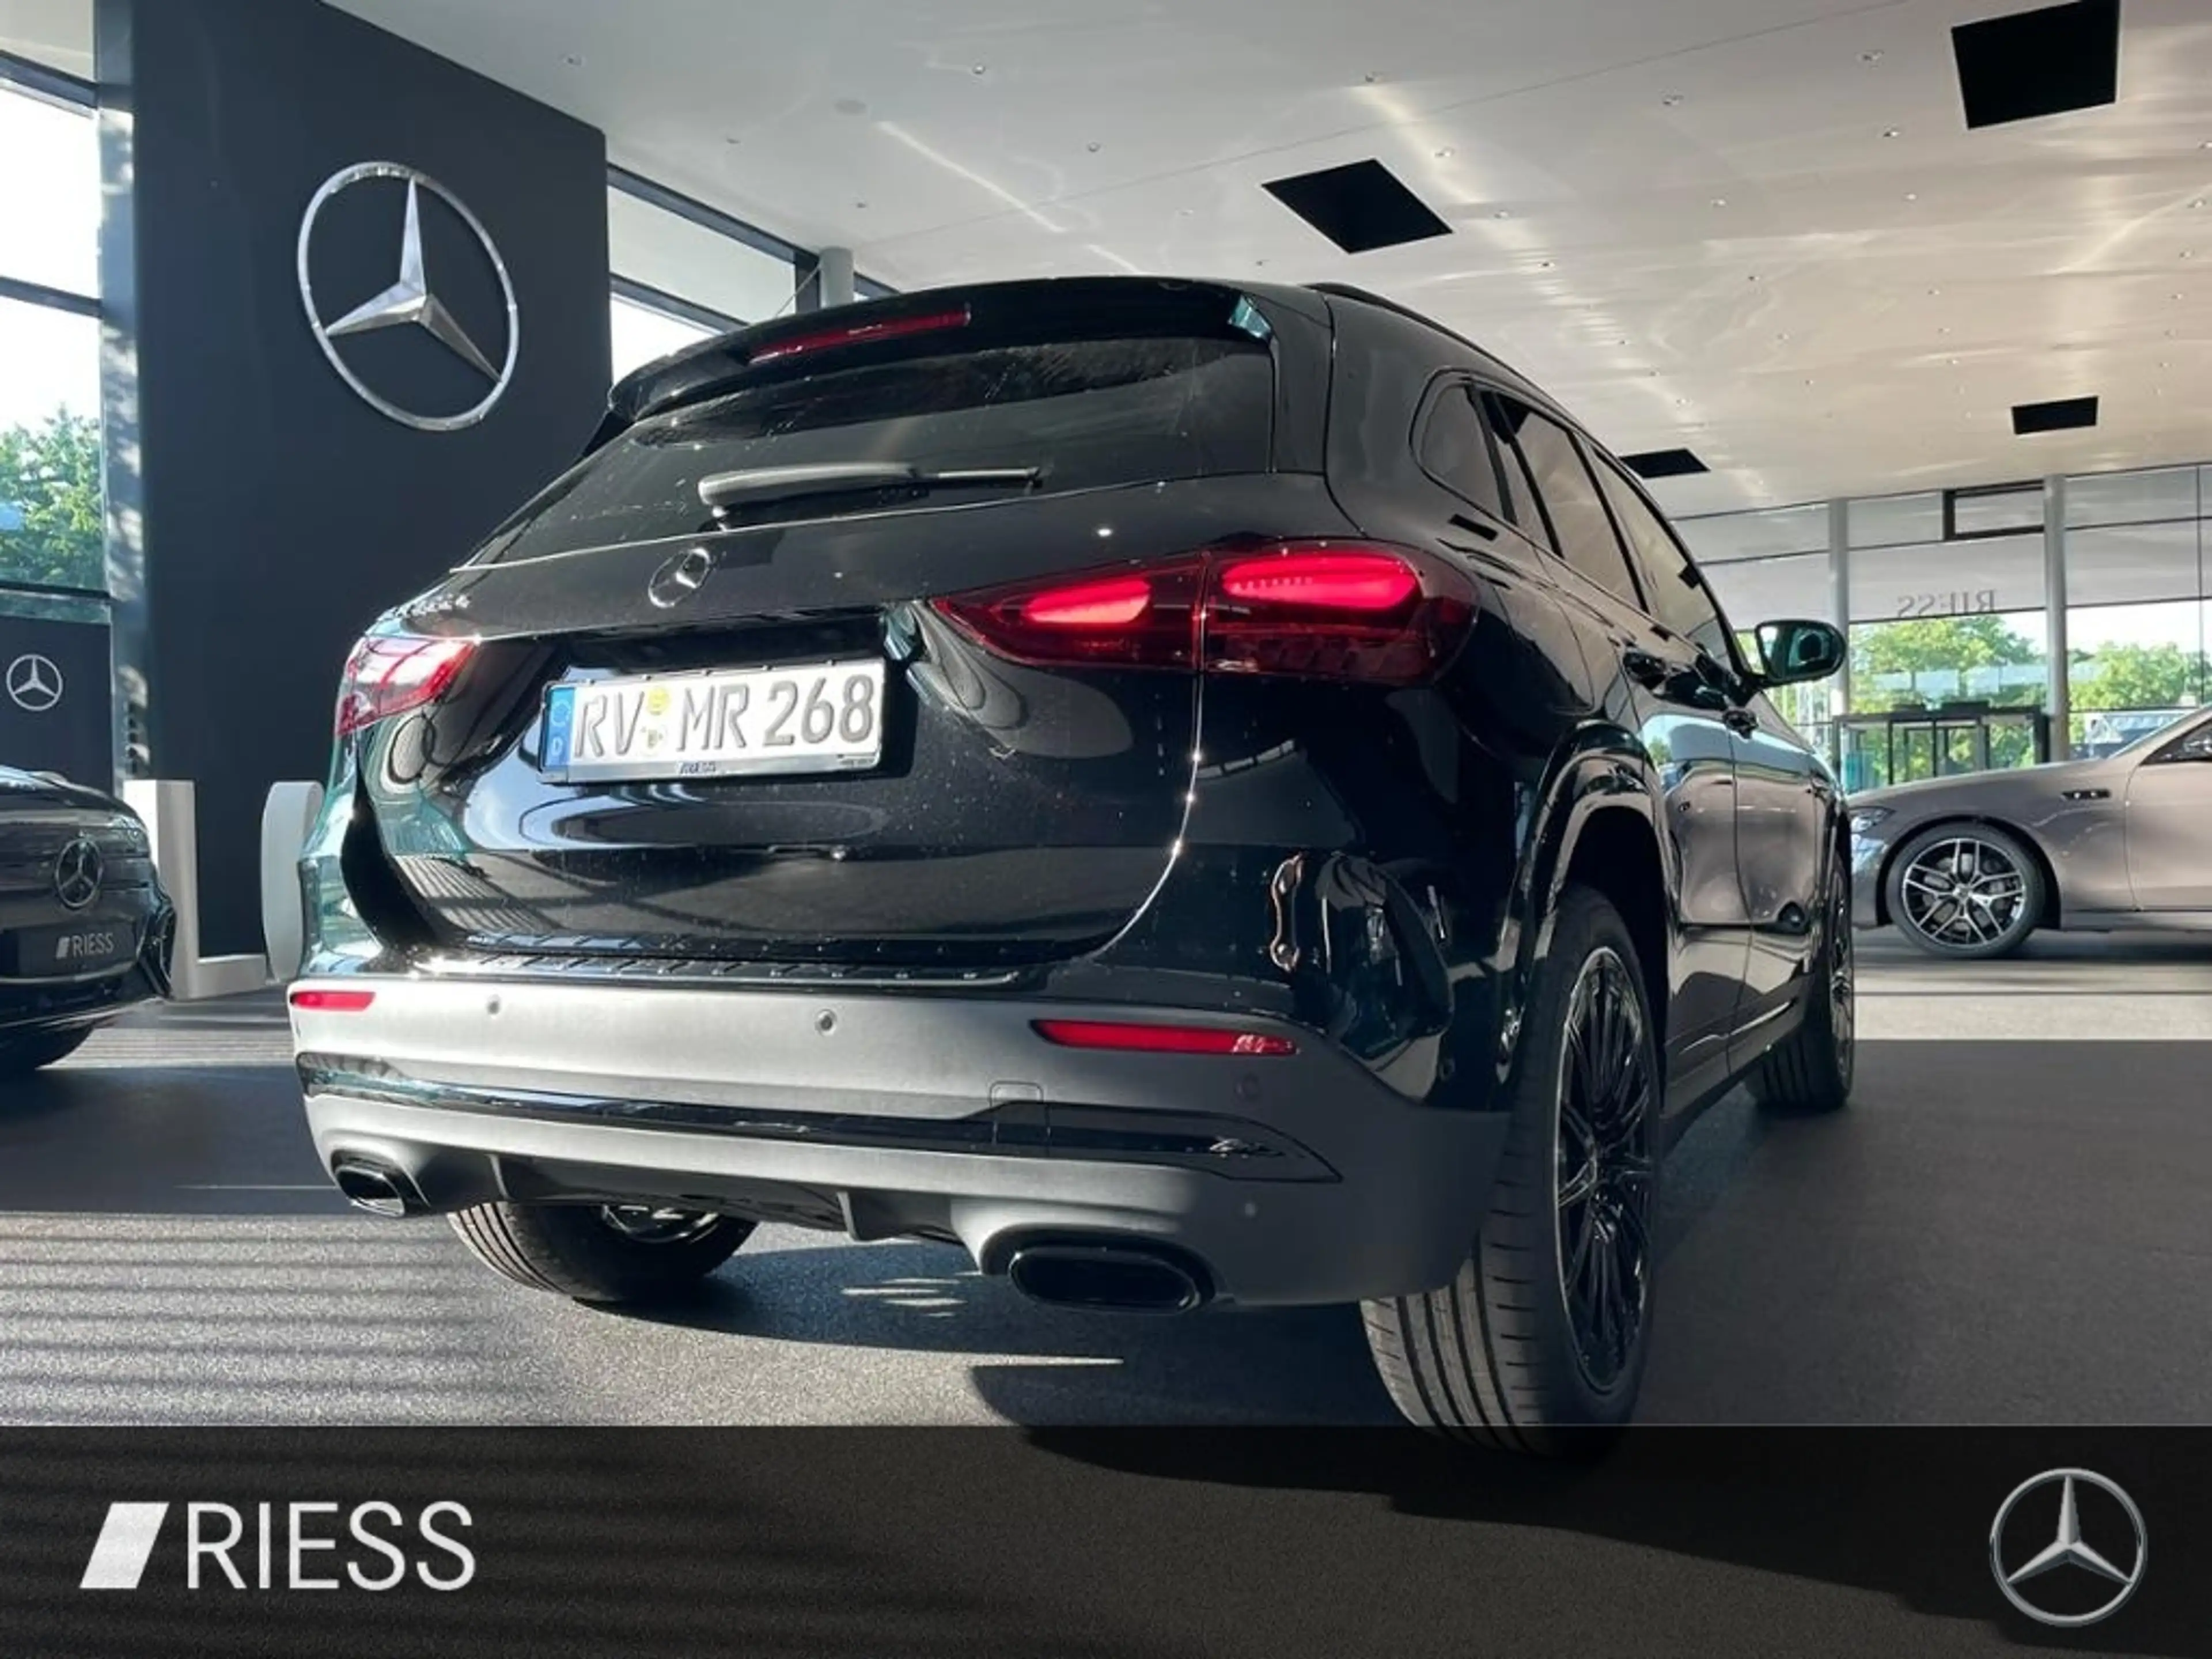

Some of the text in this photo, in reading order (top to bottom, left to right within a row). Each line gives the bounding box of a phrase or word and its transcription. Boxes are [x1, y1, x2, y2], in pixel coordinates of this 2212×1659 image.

[575, 675, 874, 757] RV MR 268
[71, 933, 114, 957] RIESS
